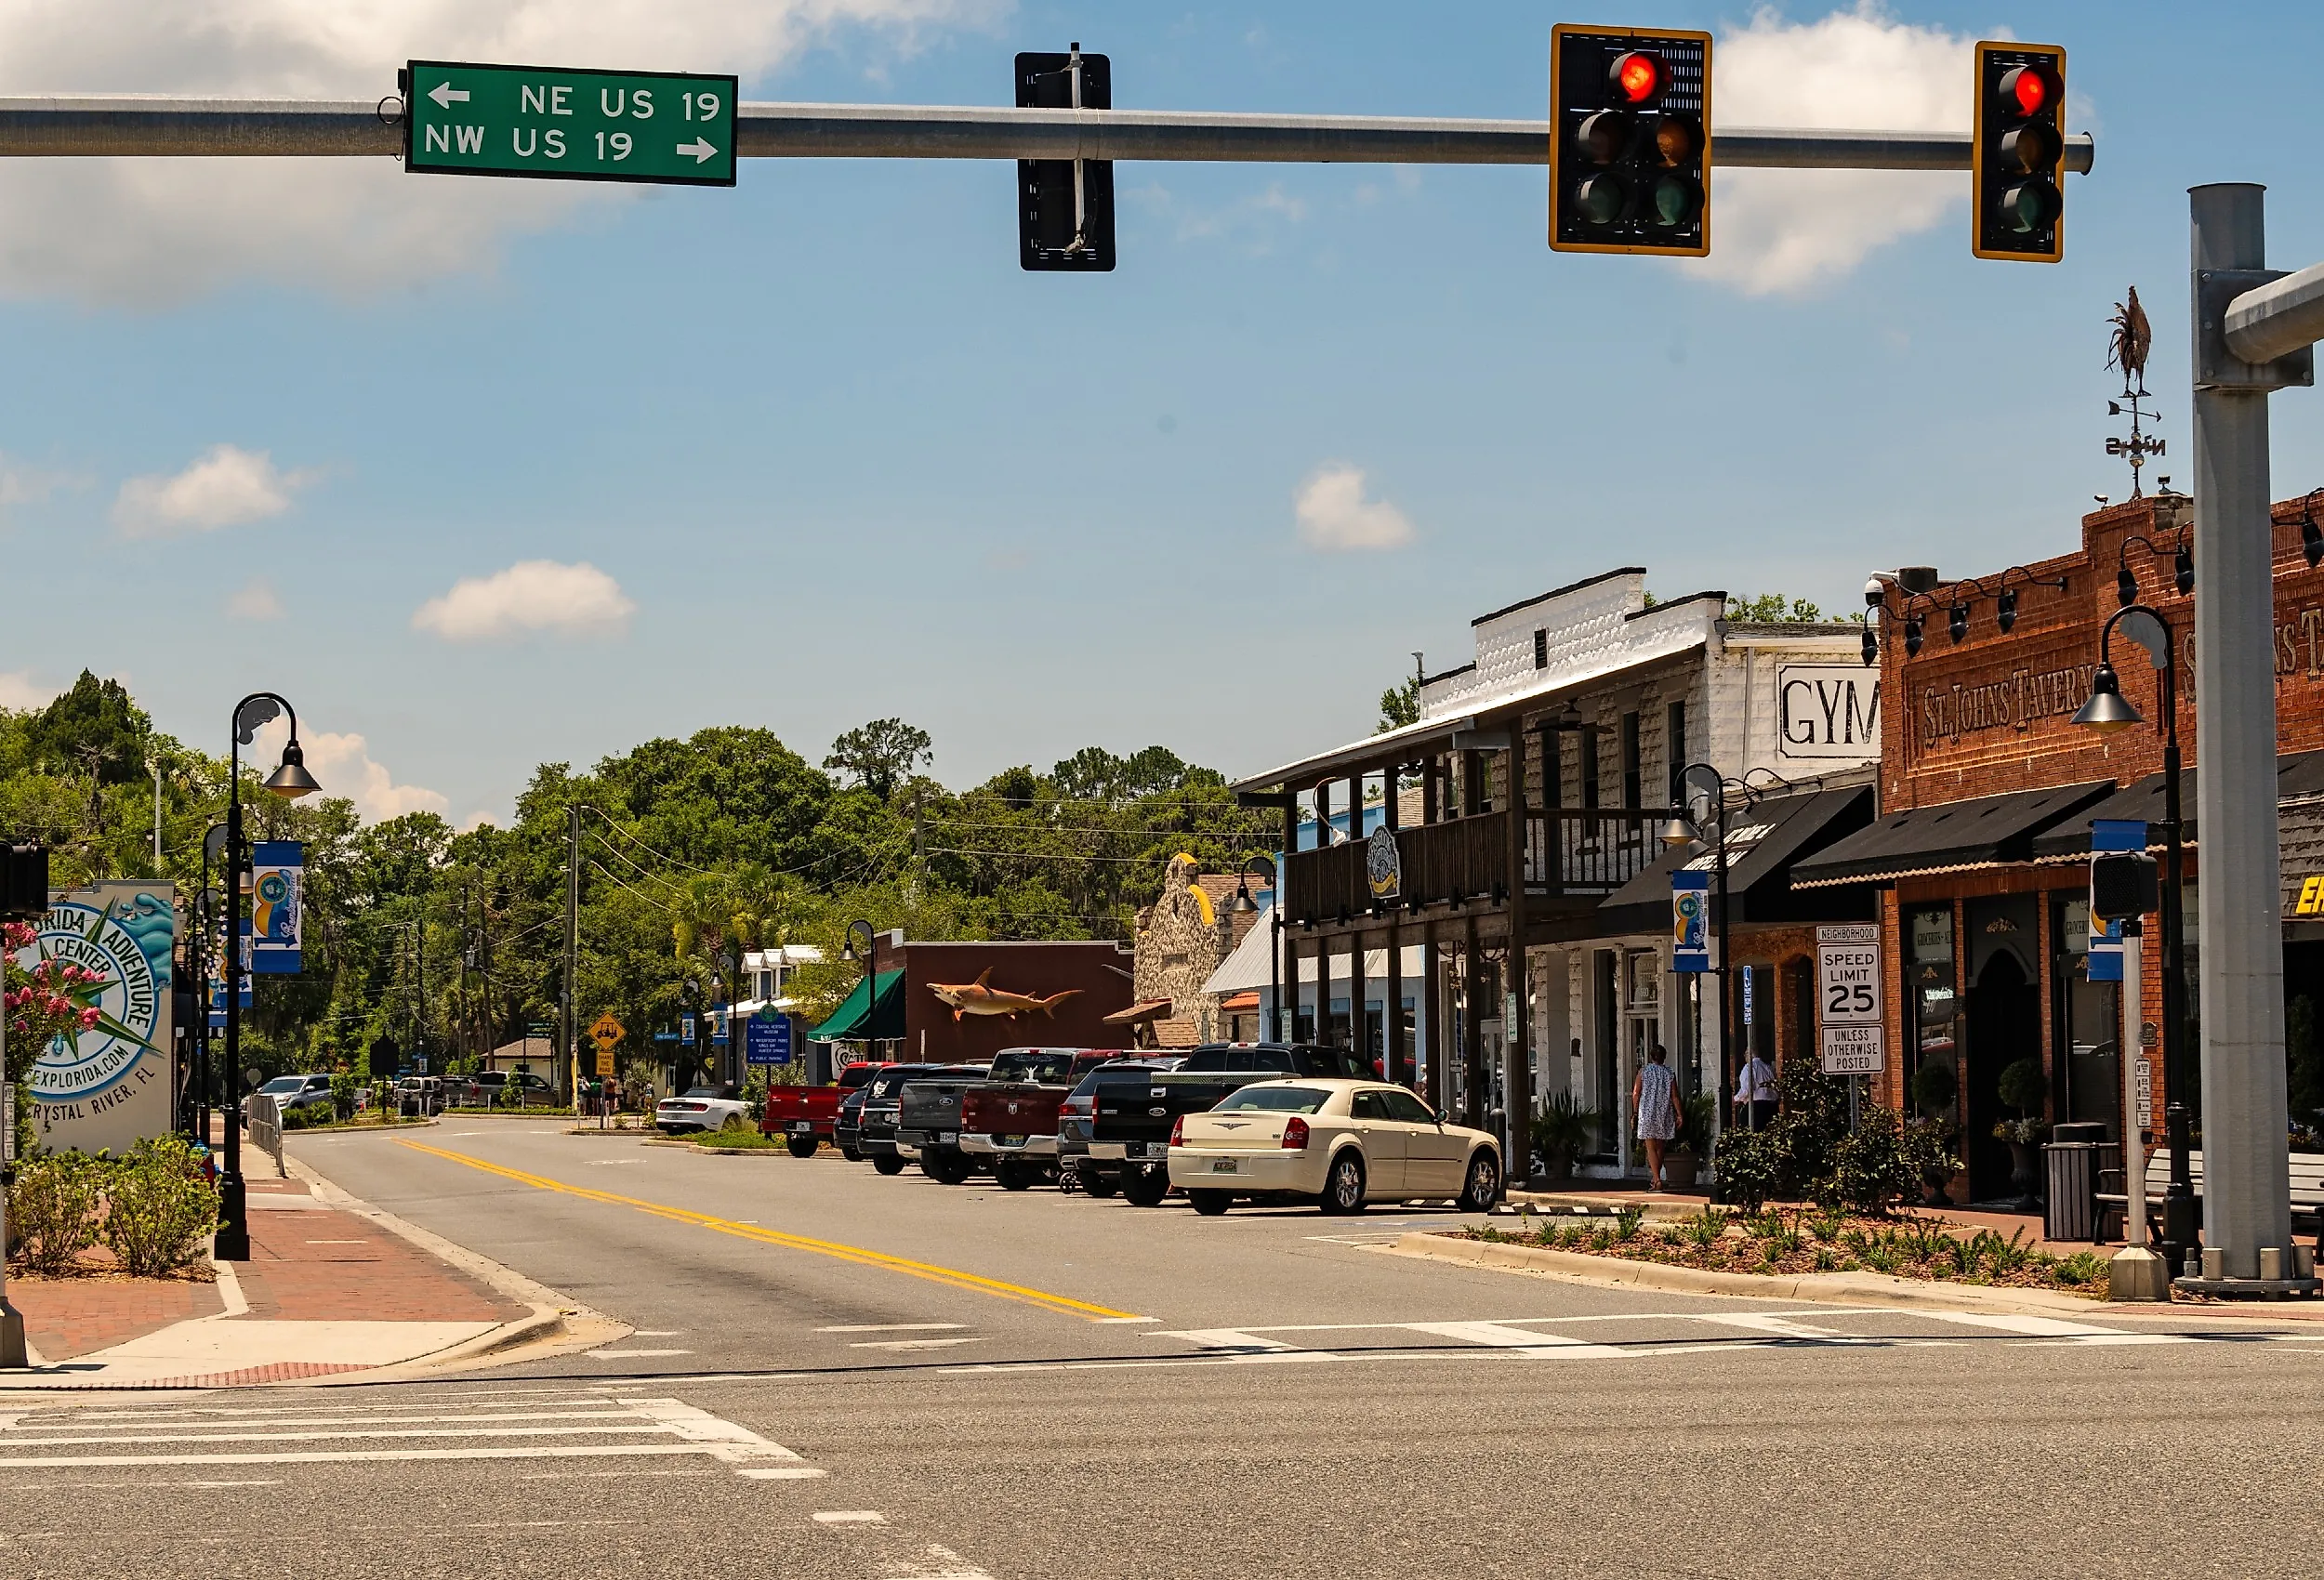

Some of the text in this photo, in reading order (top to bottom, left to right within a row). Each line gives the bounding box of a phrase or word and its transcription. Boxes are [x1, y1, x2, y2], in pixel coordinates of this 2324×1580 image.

[522, 85, 720, 122] NE US 19
[425, 124, 632, 161] NW US 19
[1782, 679, 1880, 744] GYM
[1821, 928, 1874, 940] NEIGHBORHOOD
[55, 938, 112, 974] CENTER
[1825, 954, 1874, 966] SPEED
[102, 929, 152, 1028] ADVENTURE
[1830, 969, 1868, 981] LIMIT
[1828, 985, 1874, 1013] 25
[1828, 1043, 1878, 1056] OTHERWISE
[1835, 1030, 1869, 1042] UNLESS
[1836, 1057, 1870, 1069] POSTED
[32, 1066, 155, 1121] RYSTAL RIVER, FL
